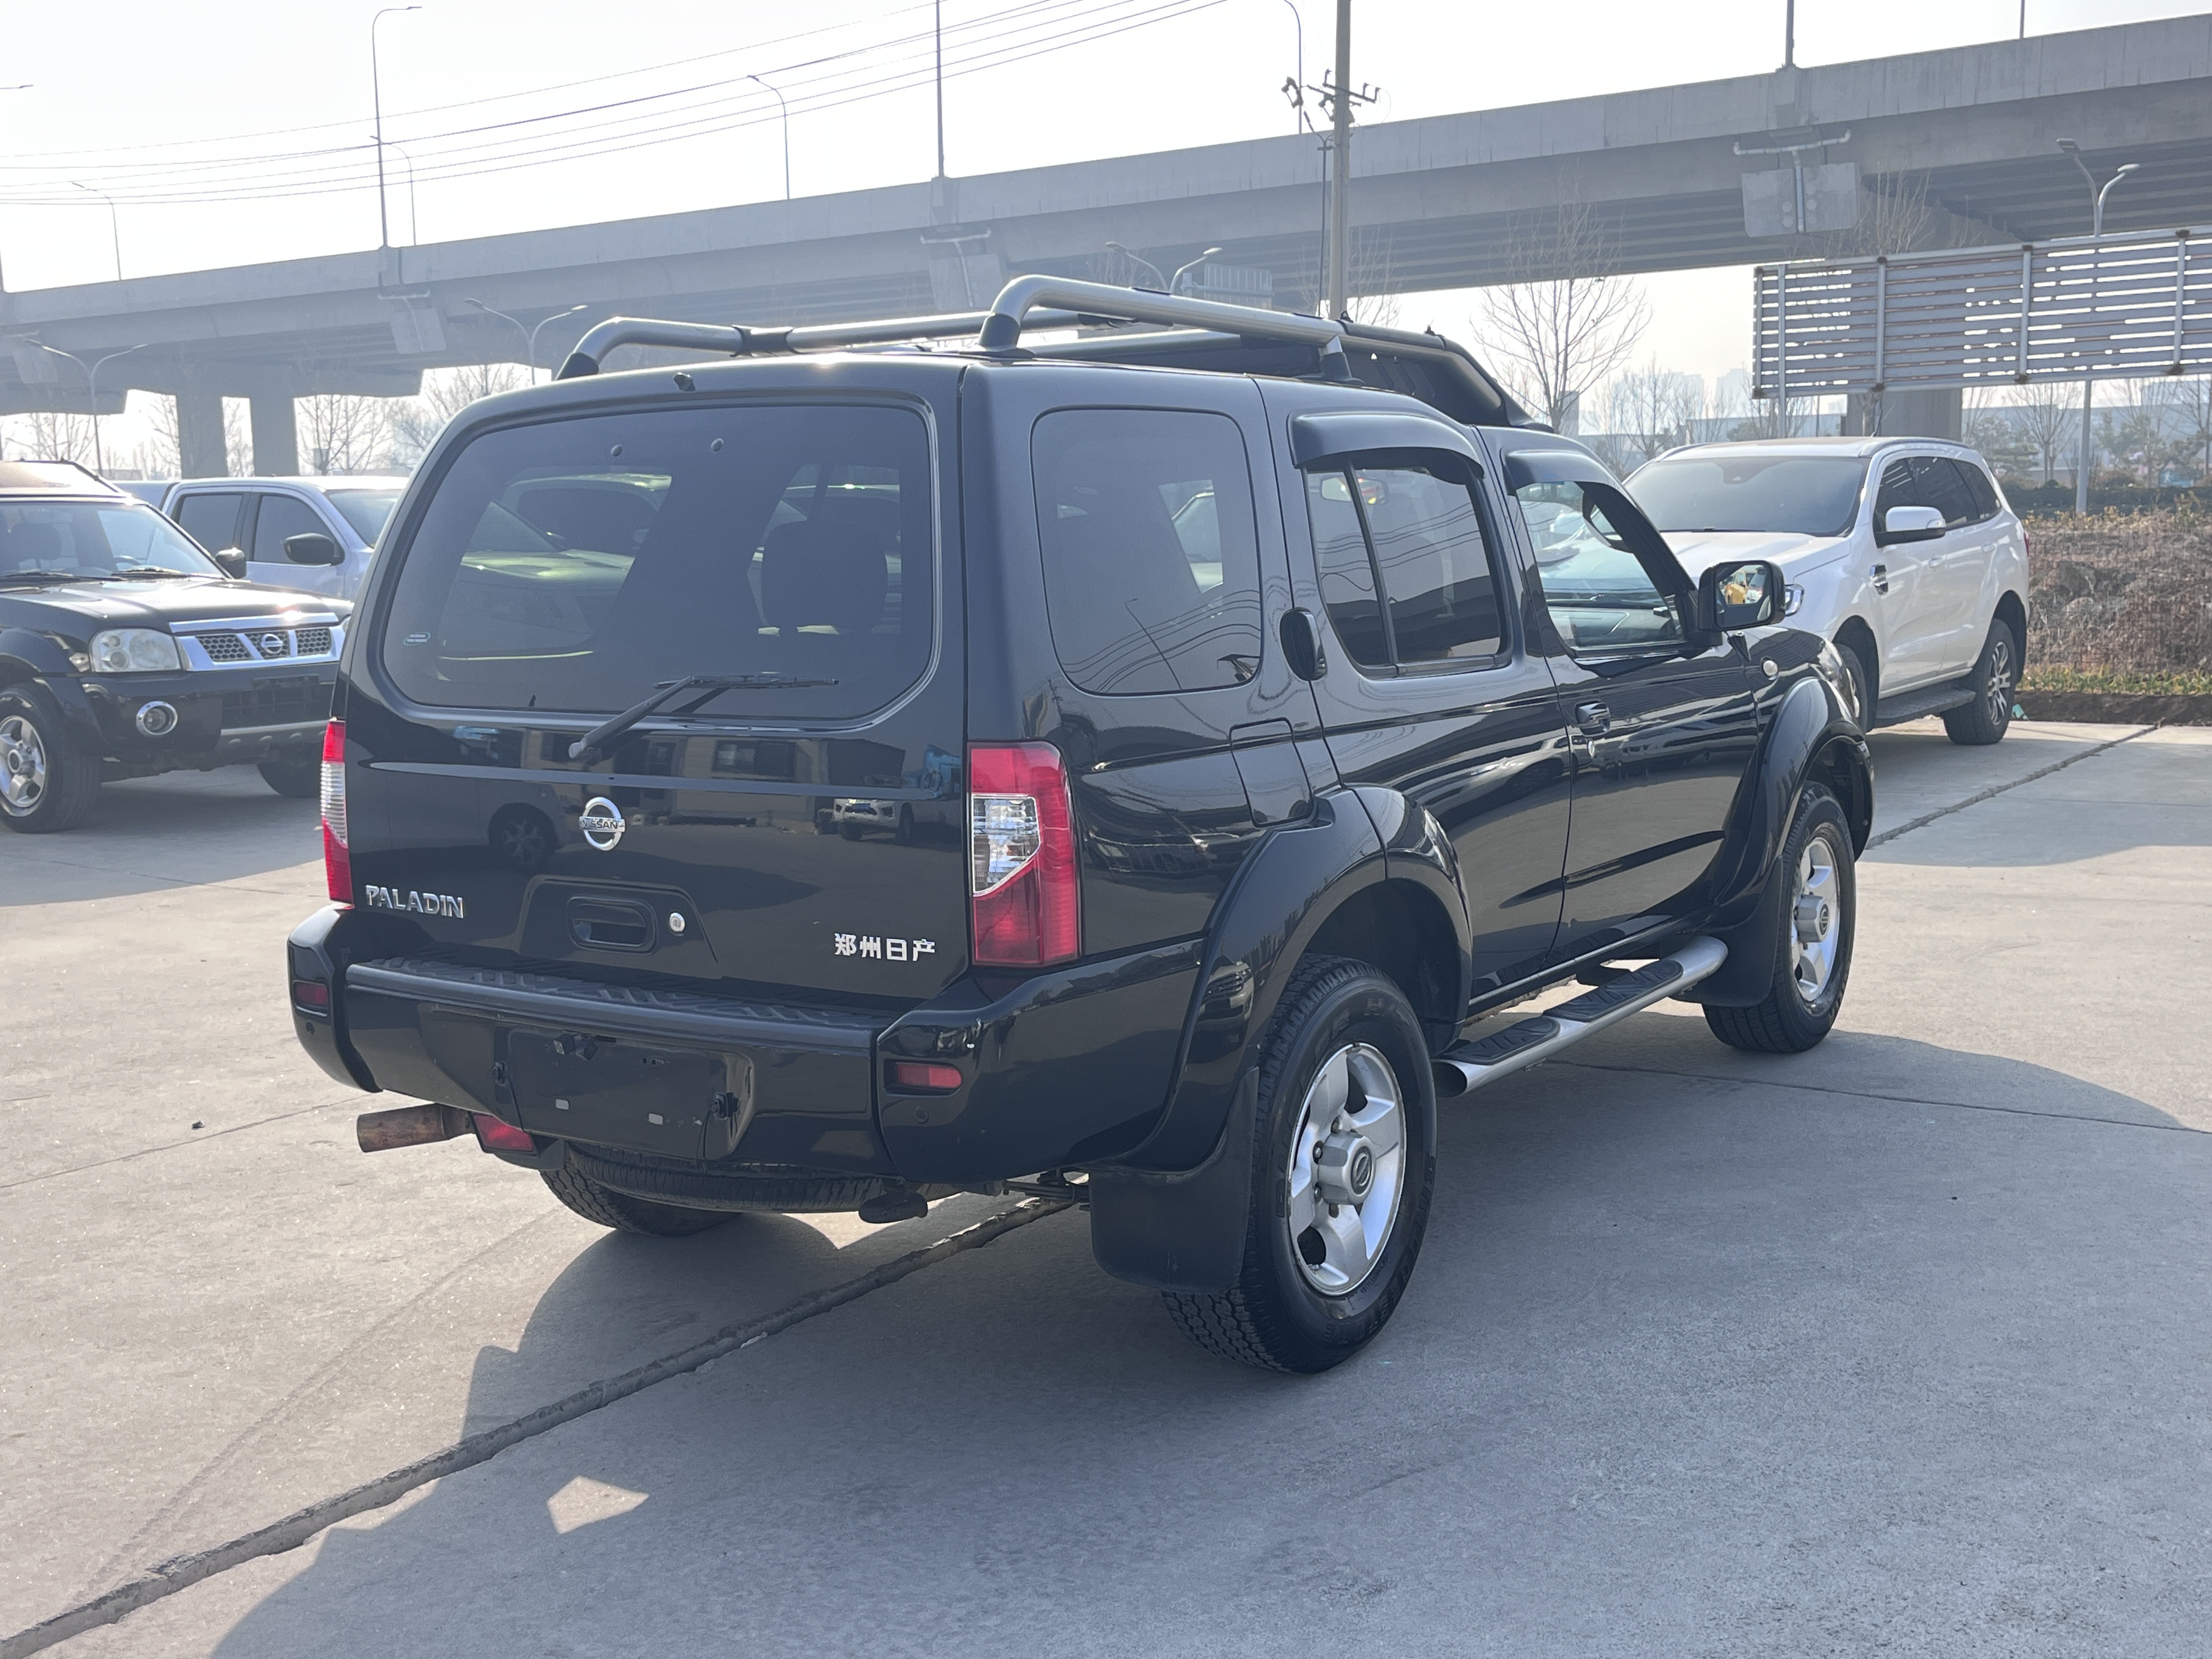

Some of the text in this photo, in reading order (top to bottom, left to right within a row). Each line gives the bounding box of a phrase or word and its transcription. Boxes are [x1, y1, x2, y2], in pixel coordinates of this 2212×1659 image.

[582, 819, 618, 830] NISSAN
[365, 884, 464, 918] PALADIN
[834, 933, 935, 961] 郑州日产
